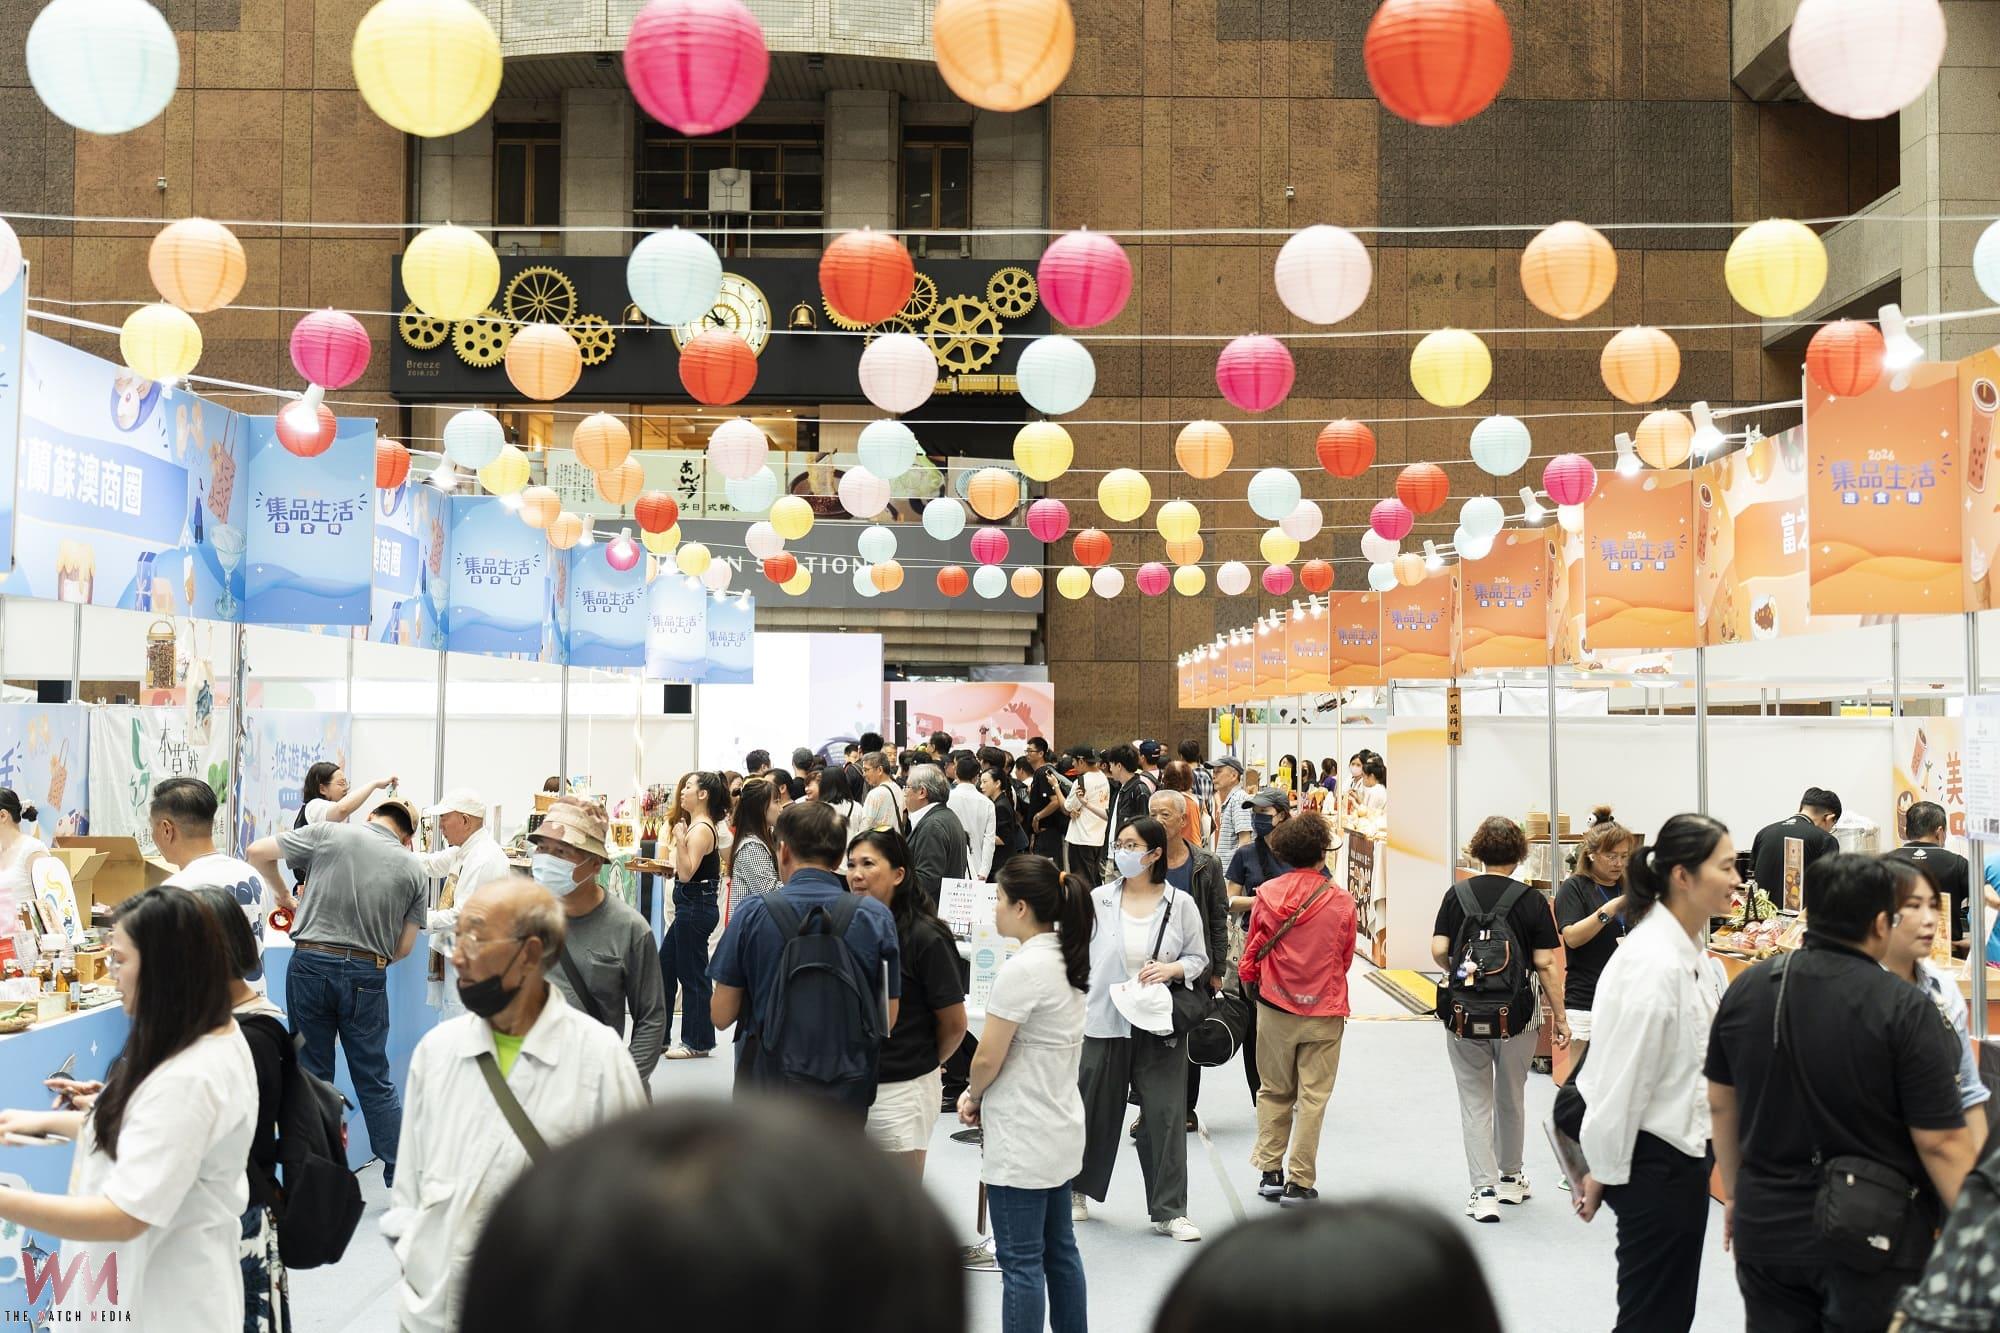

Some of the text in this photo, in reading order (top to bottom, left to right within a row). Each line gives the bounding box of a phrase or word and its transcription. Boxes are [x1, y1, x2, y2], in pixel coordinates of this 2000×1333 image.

[406, 360, 441, 369] Breeze
[1867, 449, 1895, 461] 2026
[18, 437, 143, 516] 蘭蘇澳商圈
[1831, 461, 1937, 492] 集品生活
[265, 496, 353, 522] 集品生活
[679, 503, 739, 512] 子日式豬
[1600, 540, 1677, 561] 集品生活
[464, 556, 531, 577] 集品生活
[755, 555, 869, 575] STION
[582, 590, 635, 606] 集品生活
[1474, 583, 1533, 600] 集品生活
[652, 615, 697, 627] 集品生活
